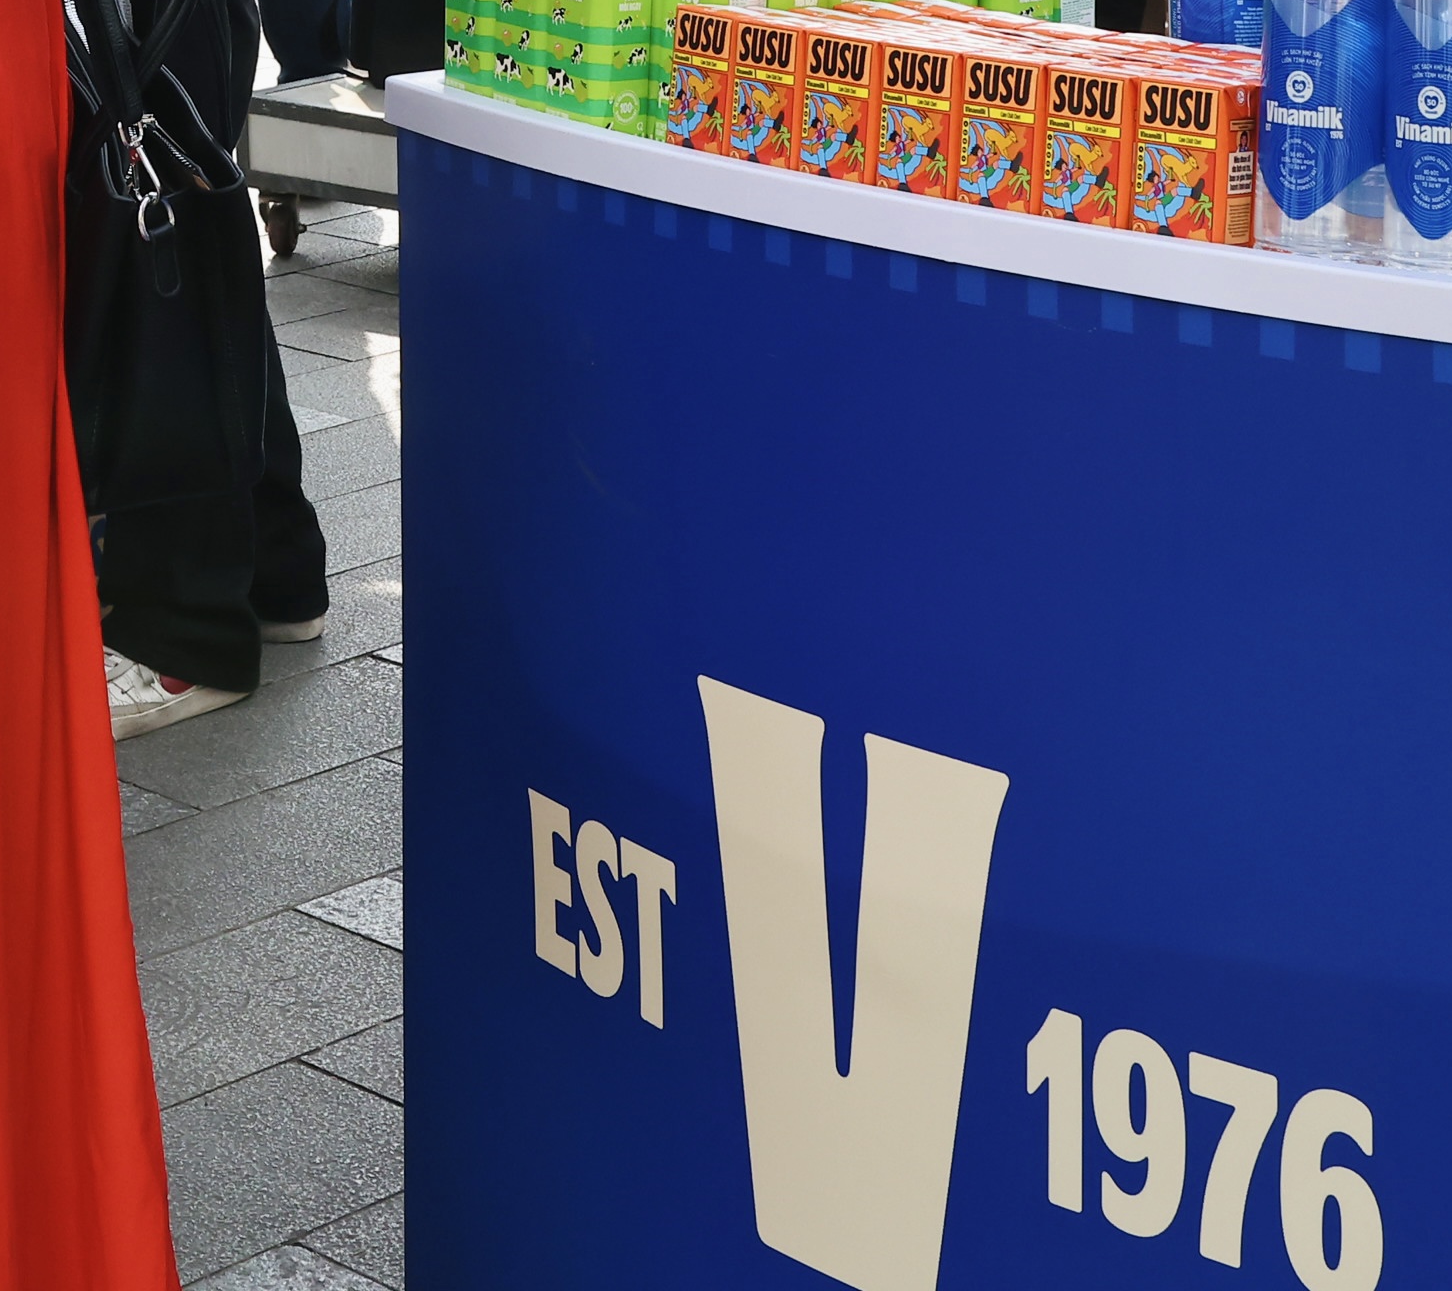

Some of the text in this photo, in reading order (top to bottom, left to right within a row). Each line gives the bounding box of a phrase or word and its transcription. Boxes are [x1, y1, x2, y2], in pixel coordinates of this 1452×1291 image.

[677, 12, 729, 56] SUSU
[739, 25, 794, 69] SUSU
[809, 37, 868, 82] SUSU
[887, 49, 949, 94] SUSU
[969, 61, 1033, 107] SUSU
[1053, 74, 1119, 120] SUSU
[1144, 84, 1213, 132] SUSU
[1266, 99, 1344, 130] Vinamilk
[528, 787, 677, 1030] EST
[697, 673, 1011, 1291] V
[1026, 1007, 1386, 1291] 1976
